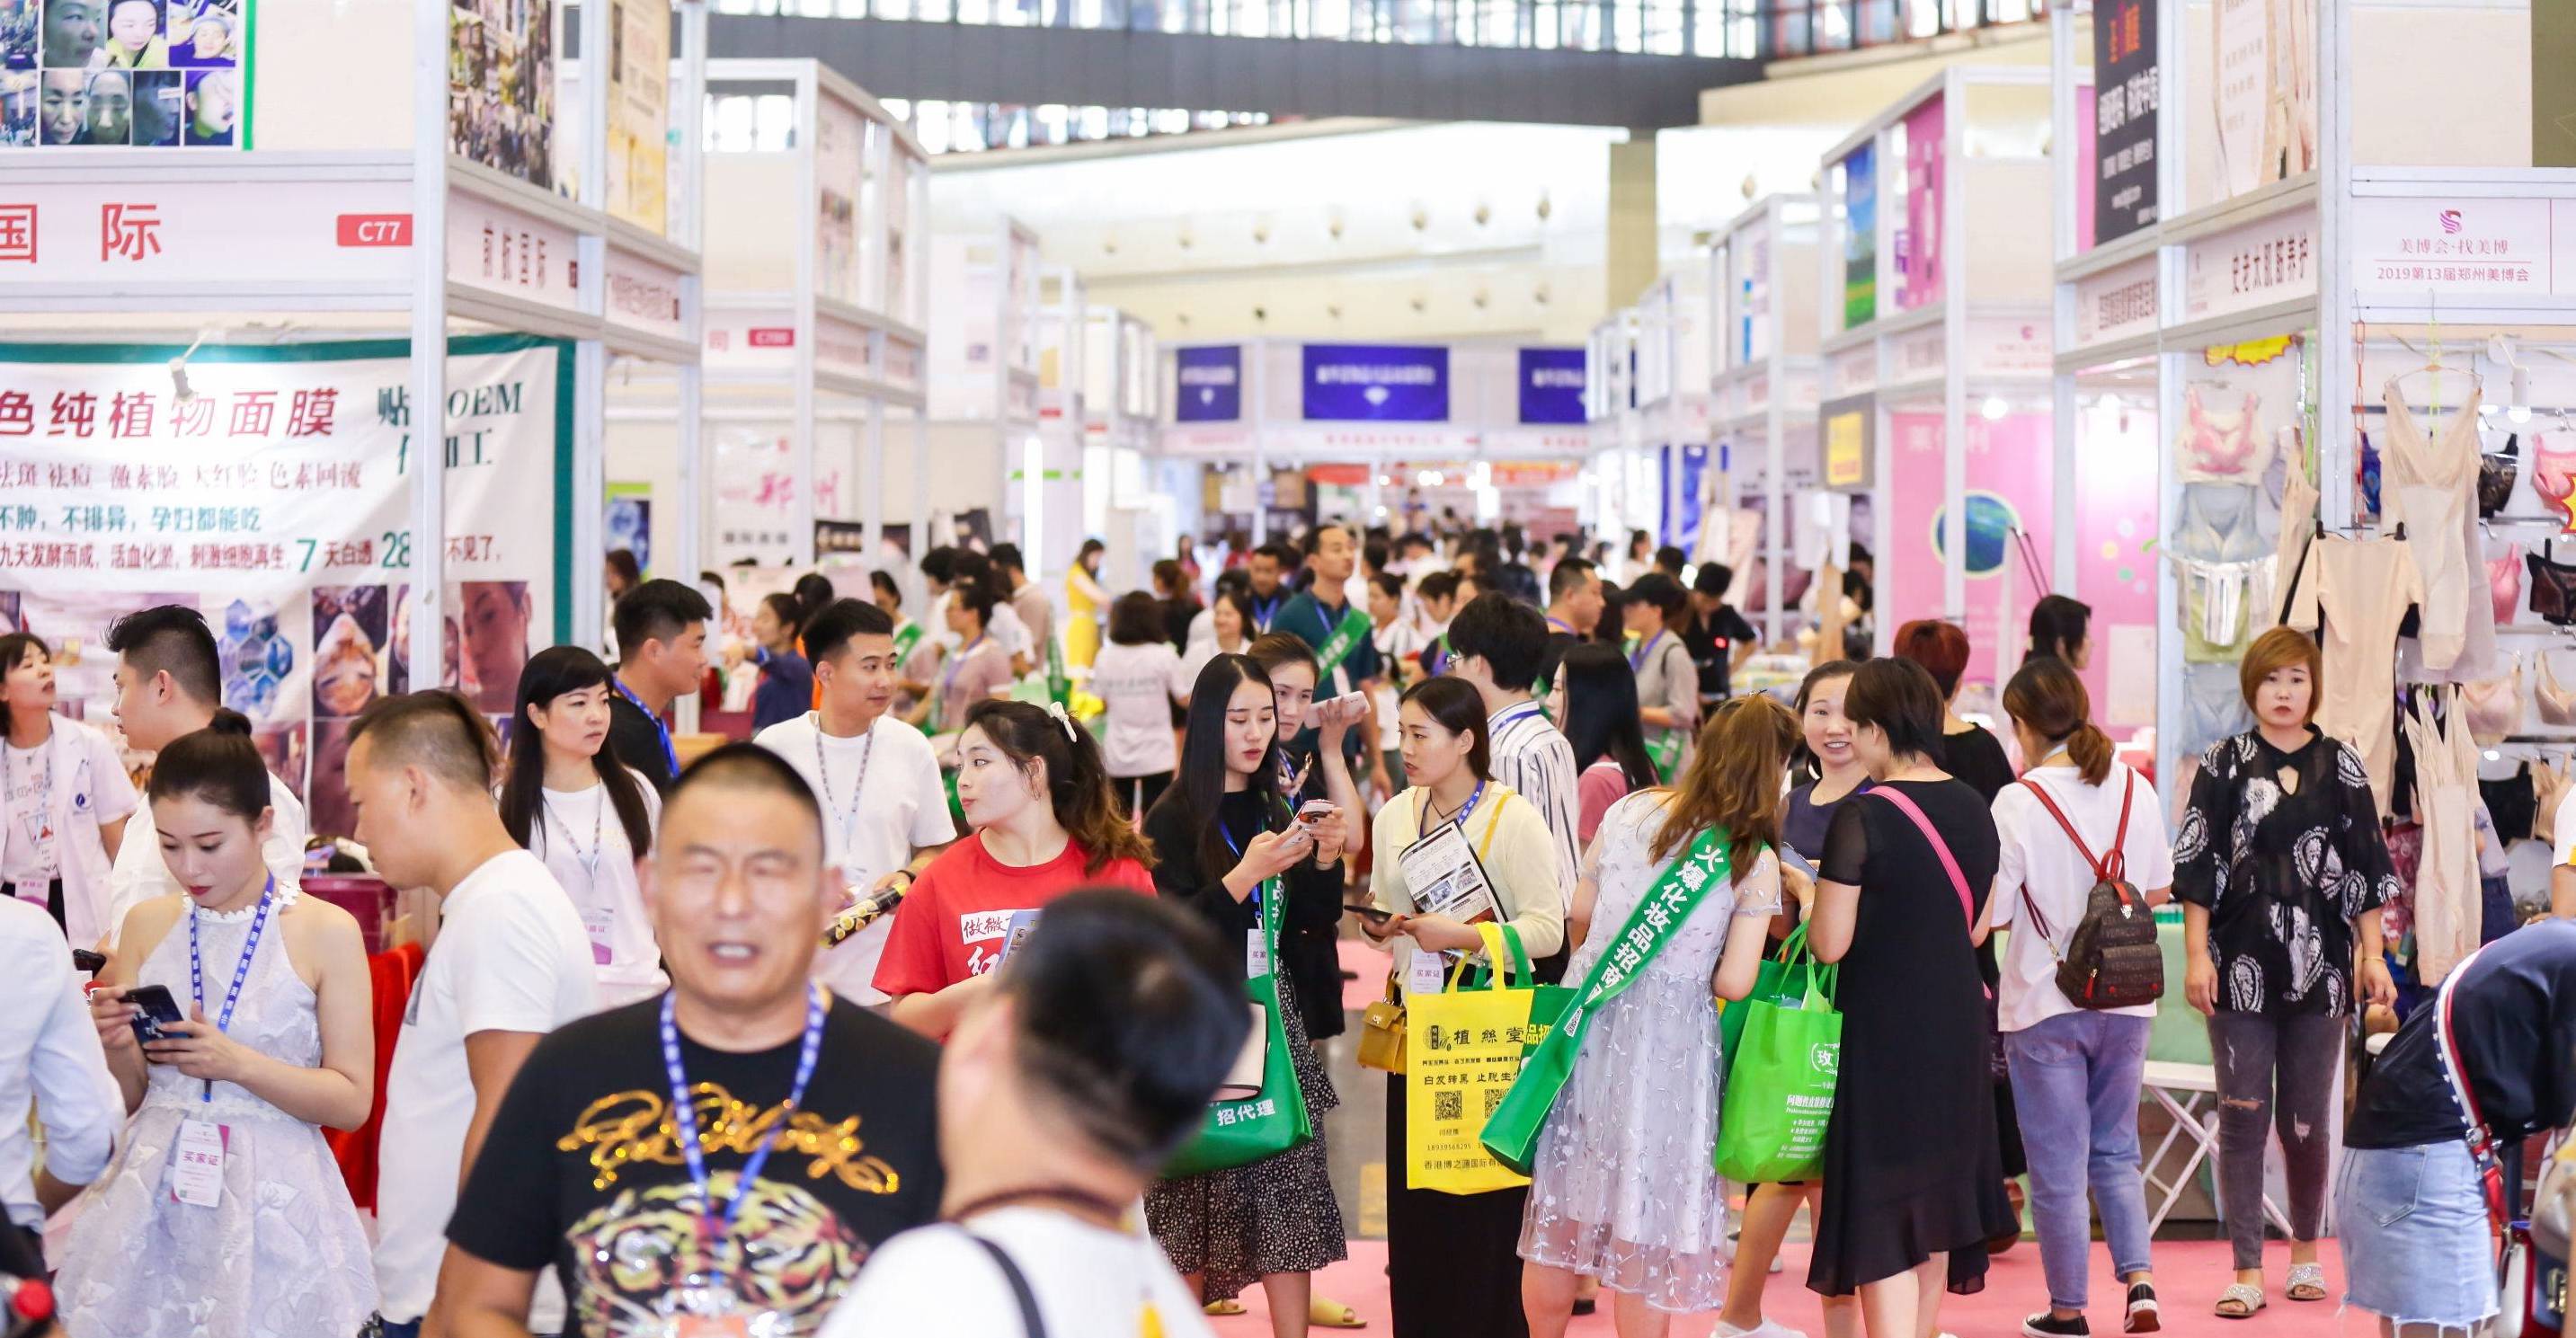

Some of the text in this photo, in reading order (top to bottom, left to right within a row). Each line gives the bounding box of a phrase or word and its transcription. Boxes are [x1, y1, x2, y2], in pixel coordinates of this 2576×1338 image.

[0, 203, 163, 263] 国际
[358, 220, 401, 243] C77
[2377, 267, 2529, 281] 2019第13届郑州美博会
[0, 388, 339, 438] 色纯植物面膜
[448, 382, 523, 419] OEM
[964, 915, 1012, 938] 做微
[1216, 1098, 1276, 1127] 招代理
